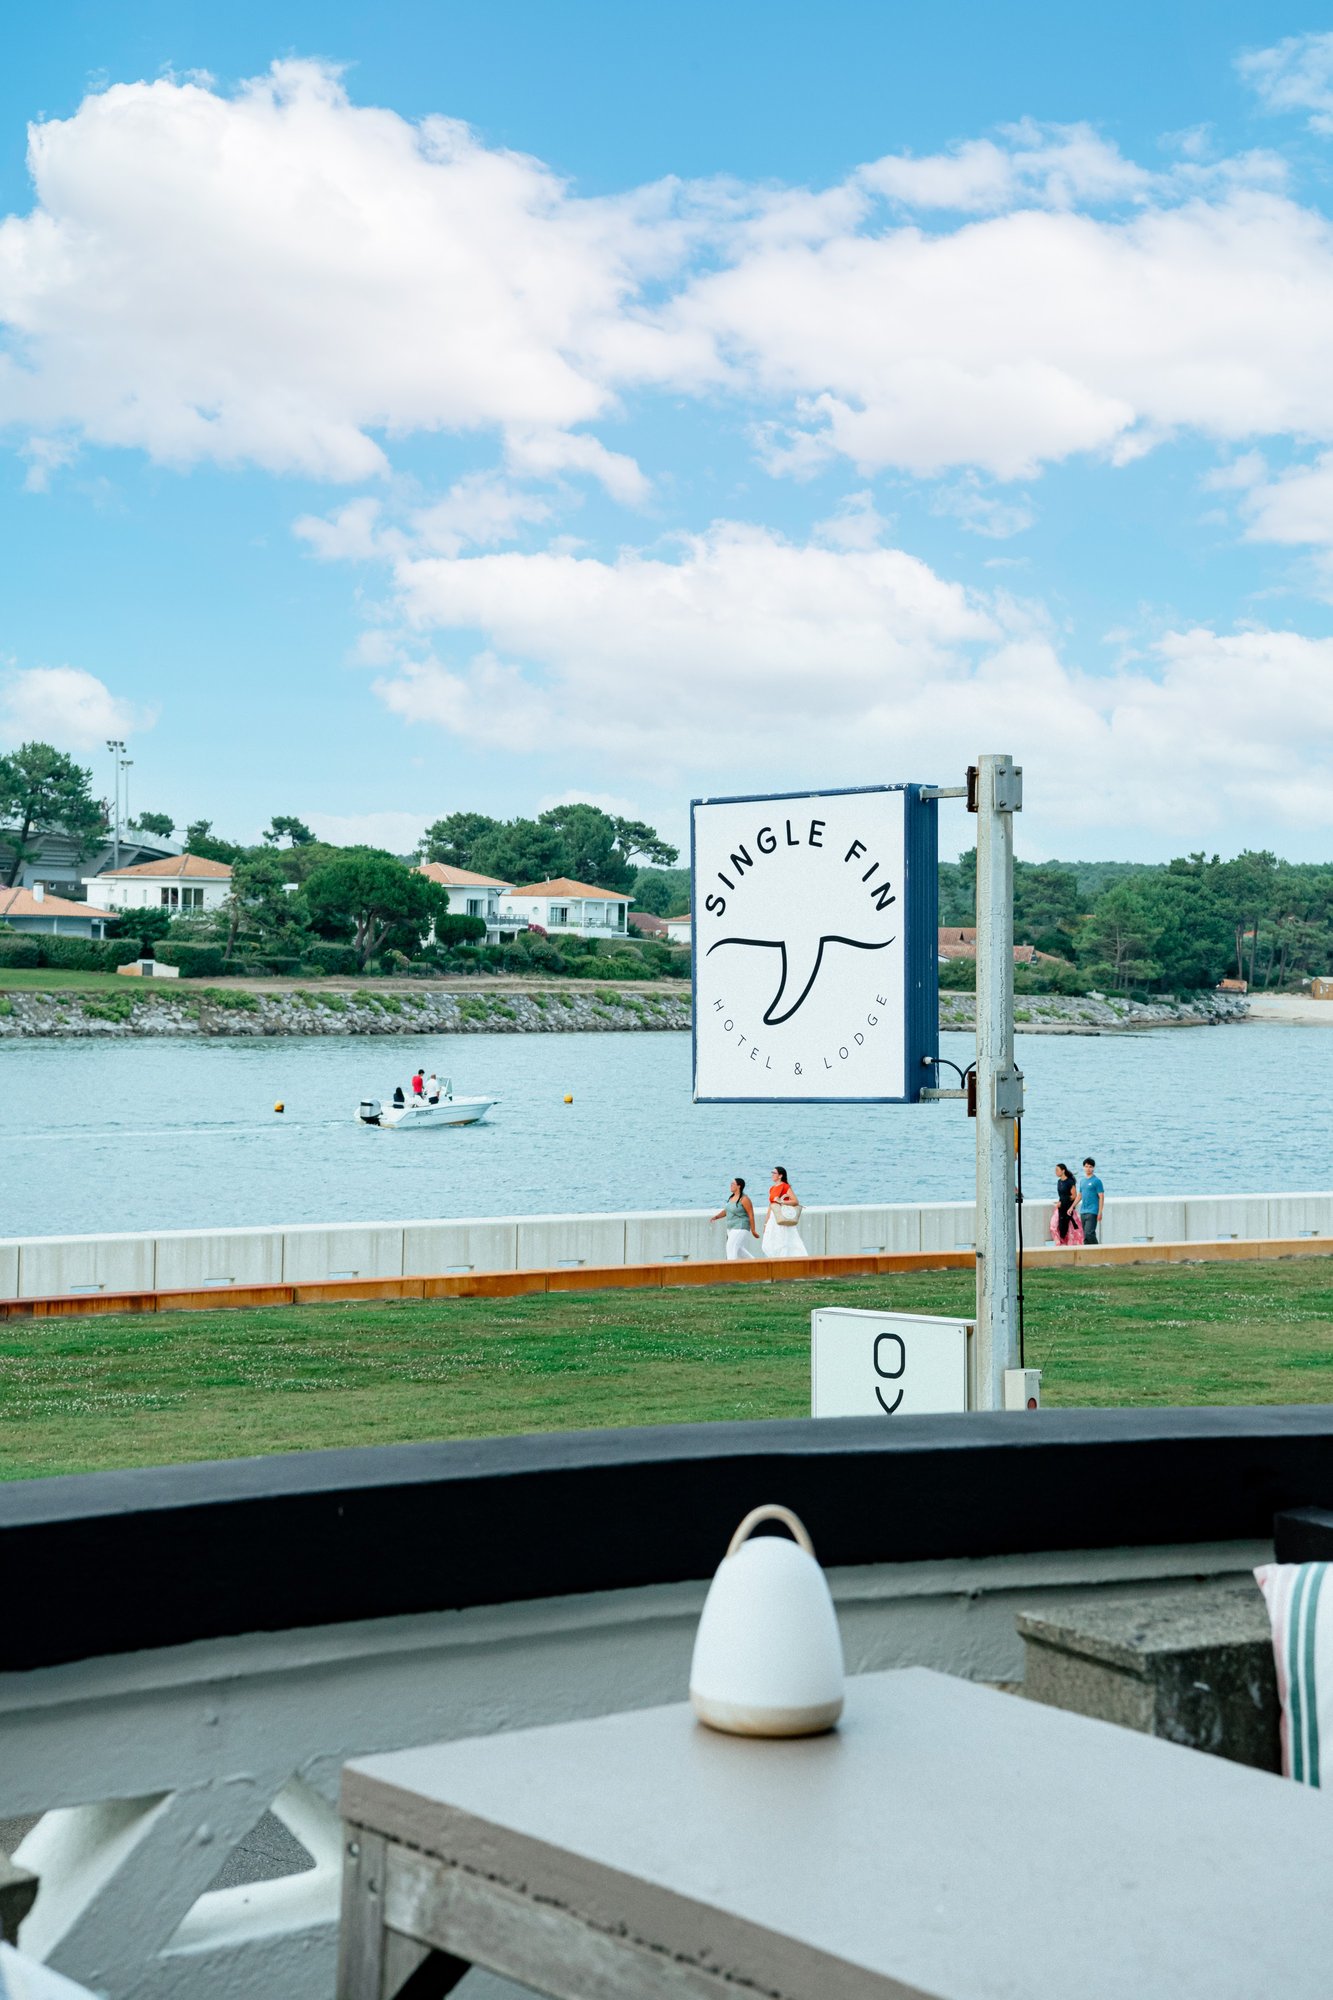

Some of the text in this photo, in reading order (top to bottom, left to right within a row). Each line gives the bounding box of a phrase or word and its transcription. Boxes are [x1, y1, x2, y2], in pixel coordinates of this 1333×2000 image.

[705, 819, 896, 917] SINGLE FIN
[712, 993, 887, 1075] HOTEL & LODGE
